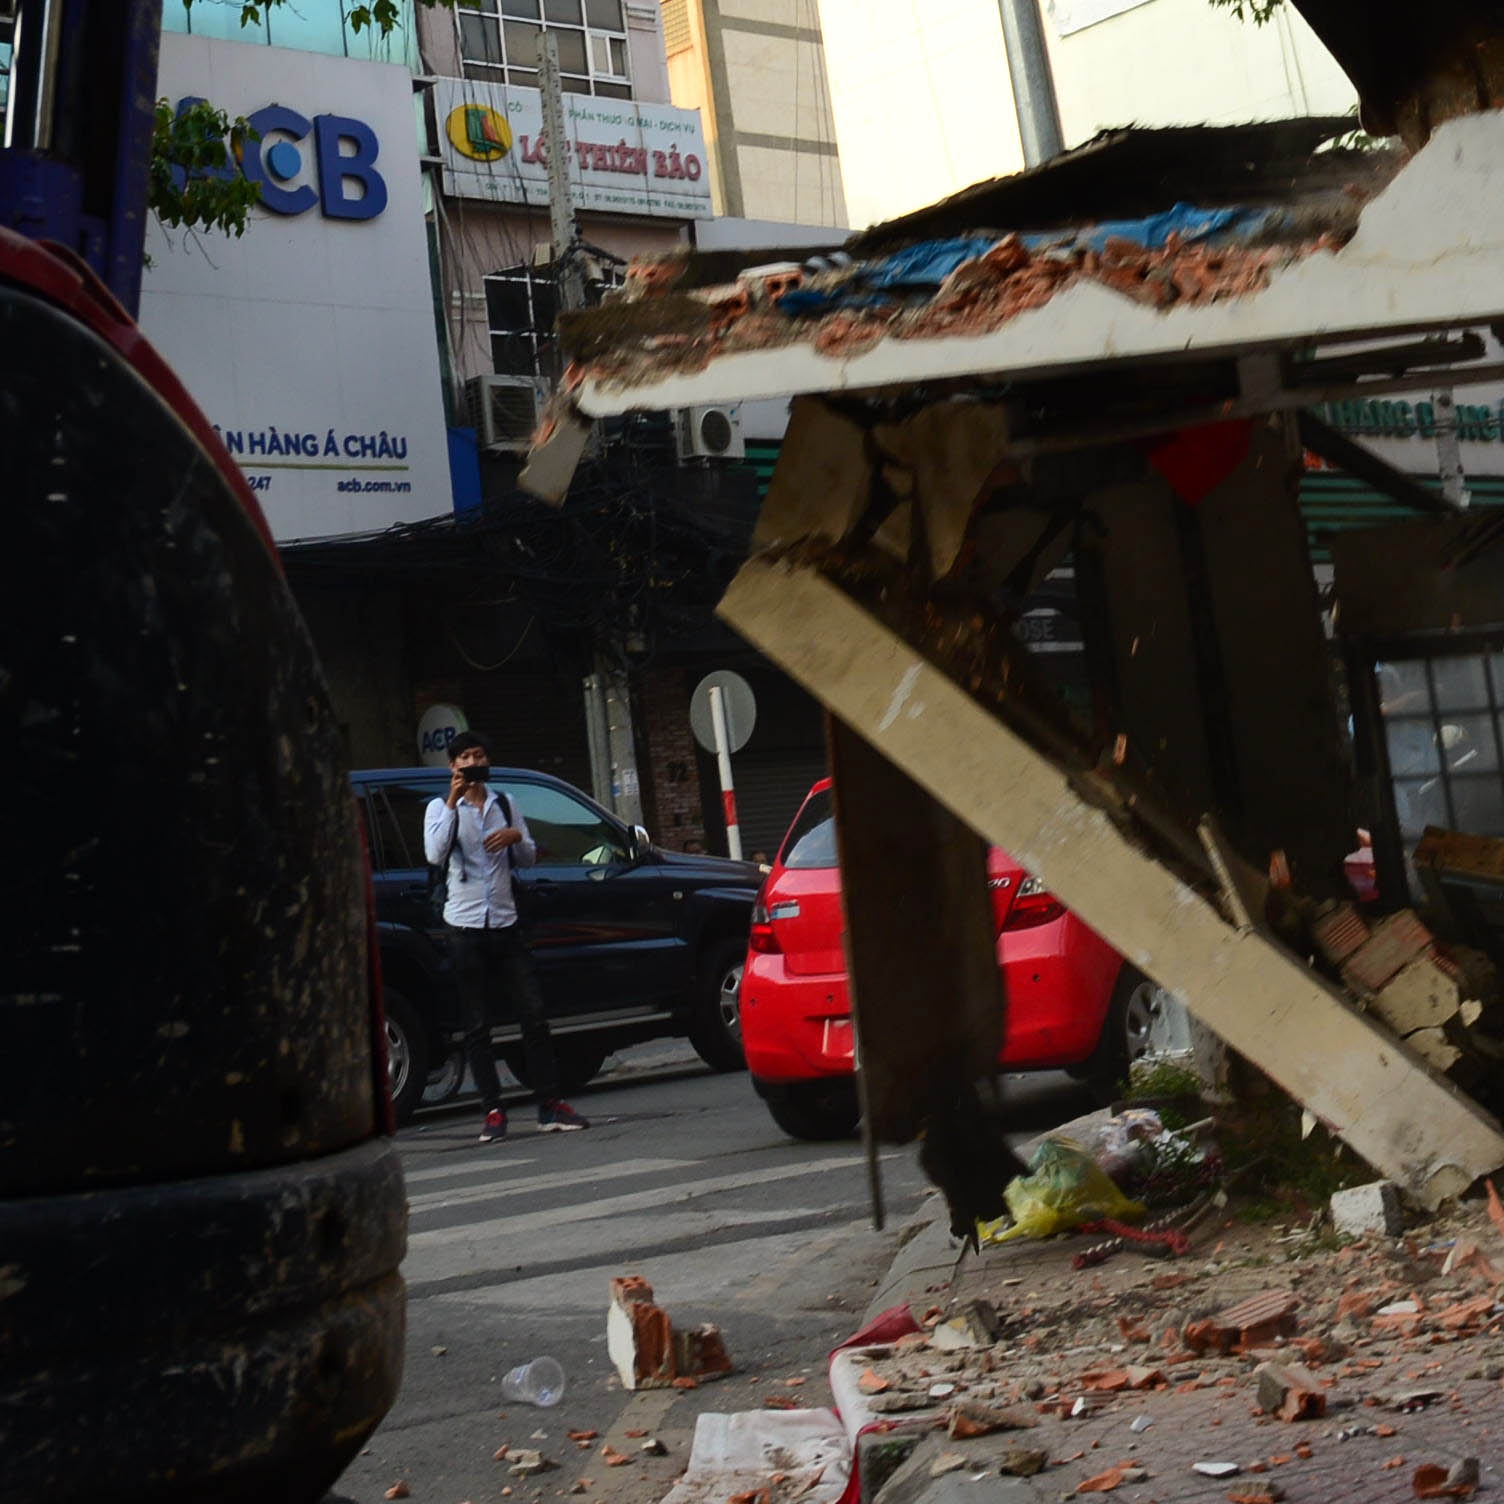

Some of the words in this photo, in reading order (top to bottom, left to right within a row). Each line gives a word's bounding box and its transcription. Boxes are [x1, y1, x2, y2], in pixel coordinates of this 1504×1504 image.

[249, 426, 320, 457] HÀNG
[323, 428, 340, 457] Á
[343, 430, 407, 459] CHÂU
[337, 477, 411, 493] acb.com.vn
